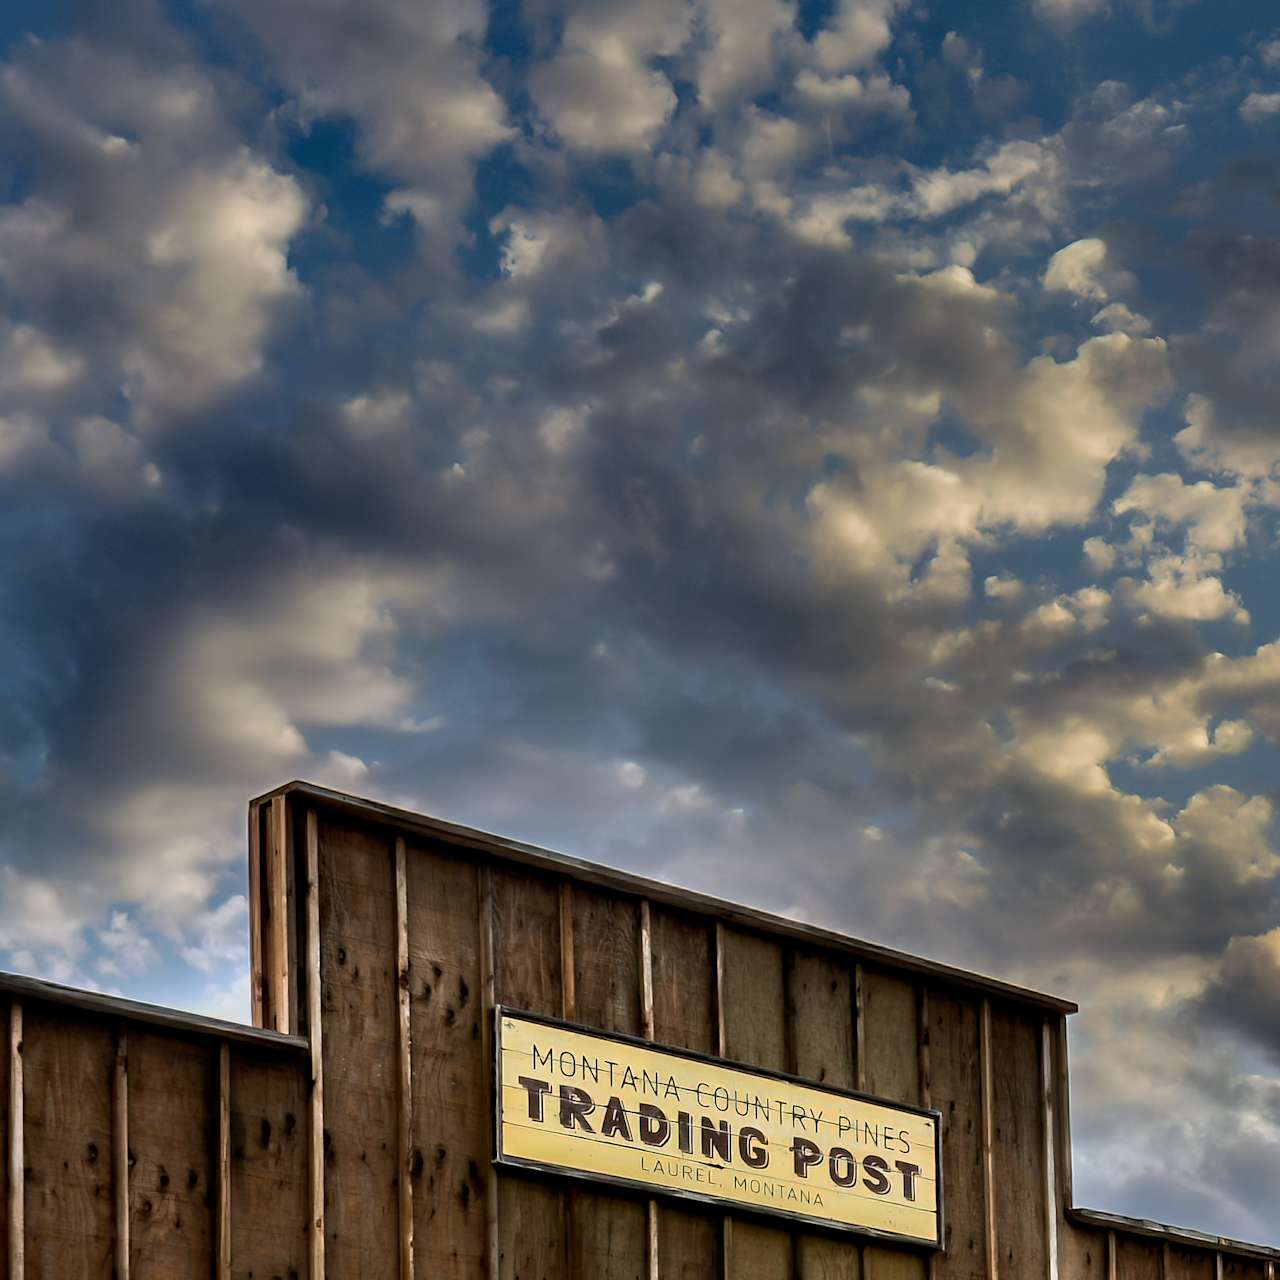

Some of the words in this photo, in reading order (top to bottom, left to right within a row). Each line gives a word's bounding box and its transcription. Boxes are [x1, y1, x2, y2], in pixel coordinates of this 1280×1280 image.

[517, 1075, 770, 1170] TRADING
[791, 1136, 922, 1202] POST
[532, 1043, 681, 1102] MONTANA
[696, 1082, 824, 1134] COUNTRY
[838, 1115, 911, 1154] PINES
[733, 1175, 825, 1208] MONTANA
